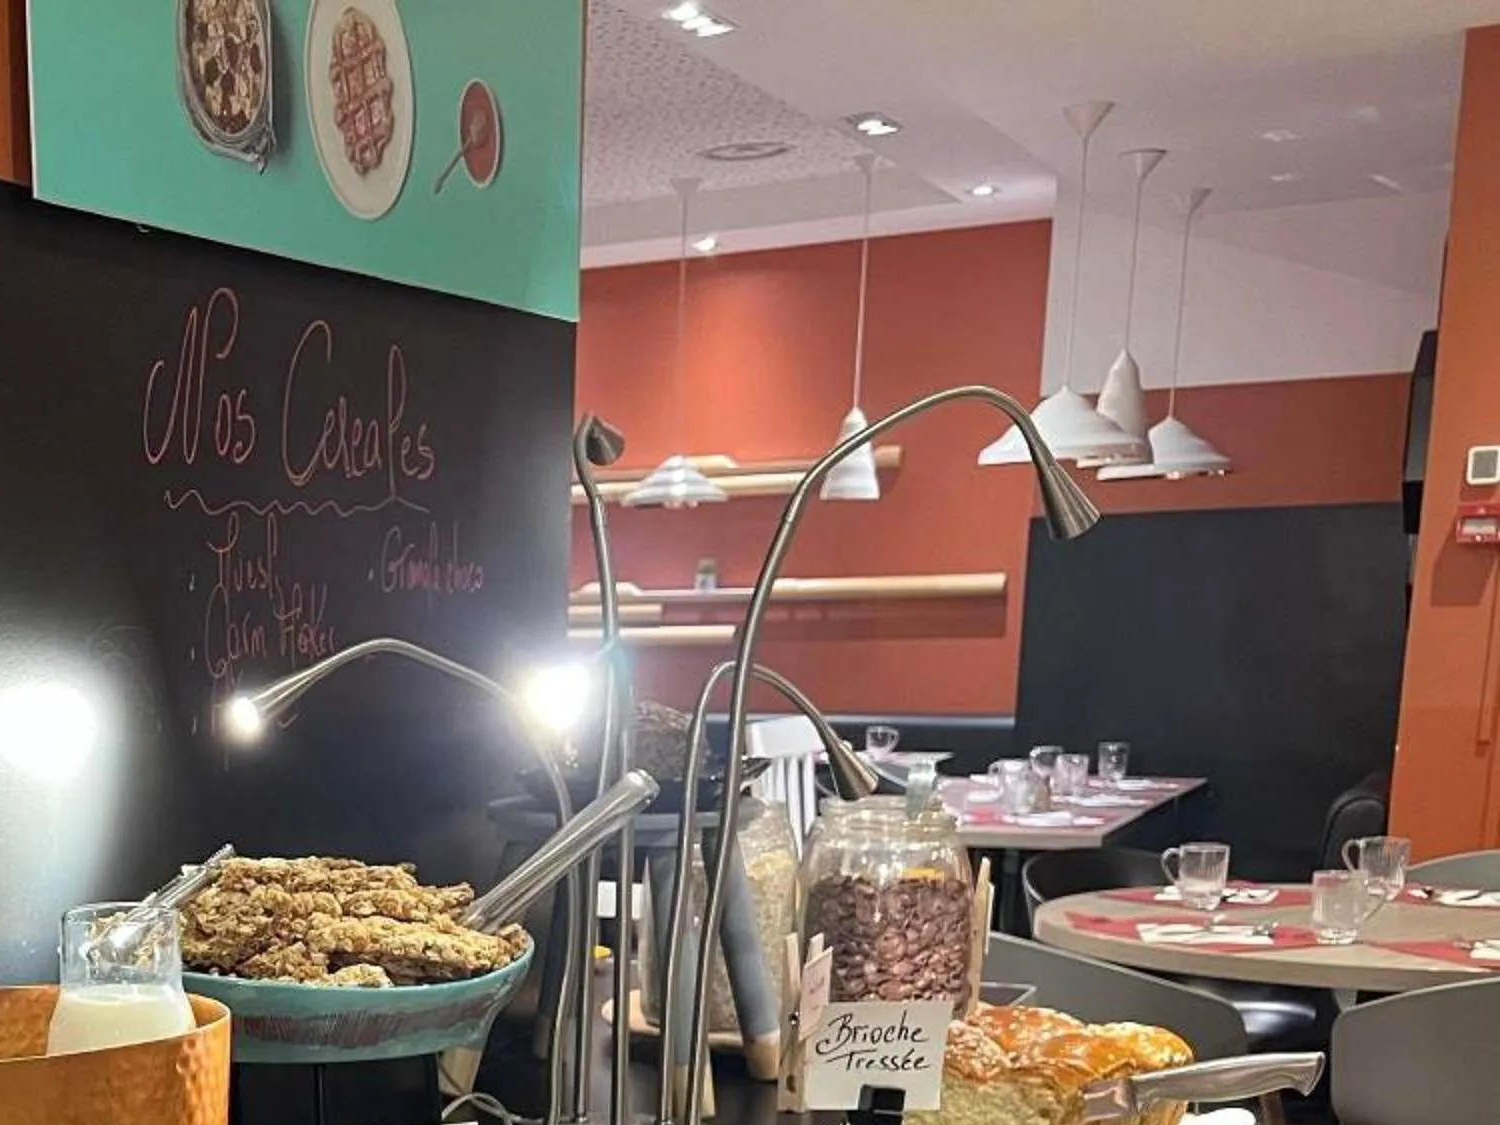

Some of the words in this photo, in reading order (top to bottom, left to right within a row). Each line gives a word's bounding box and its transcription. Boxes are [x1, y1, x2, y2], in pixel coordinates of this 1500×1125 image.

[143, 287, 257, 465] Nos
[815, 1010, 930, 1055] Brioche
[825, 1047, 931, 1072] Tressée
